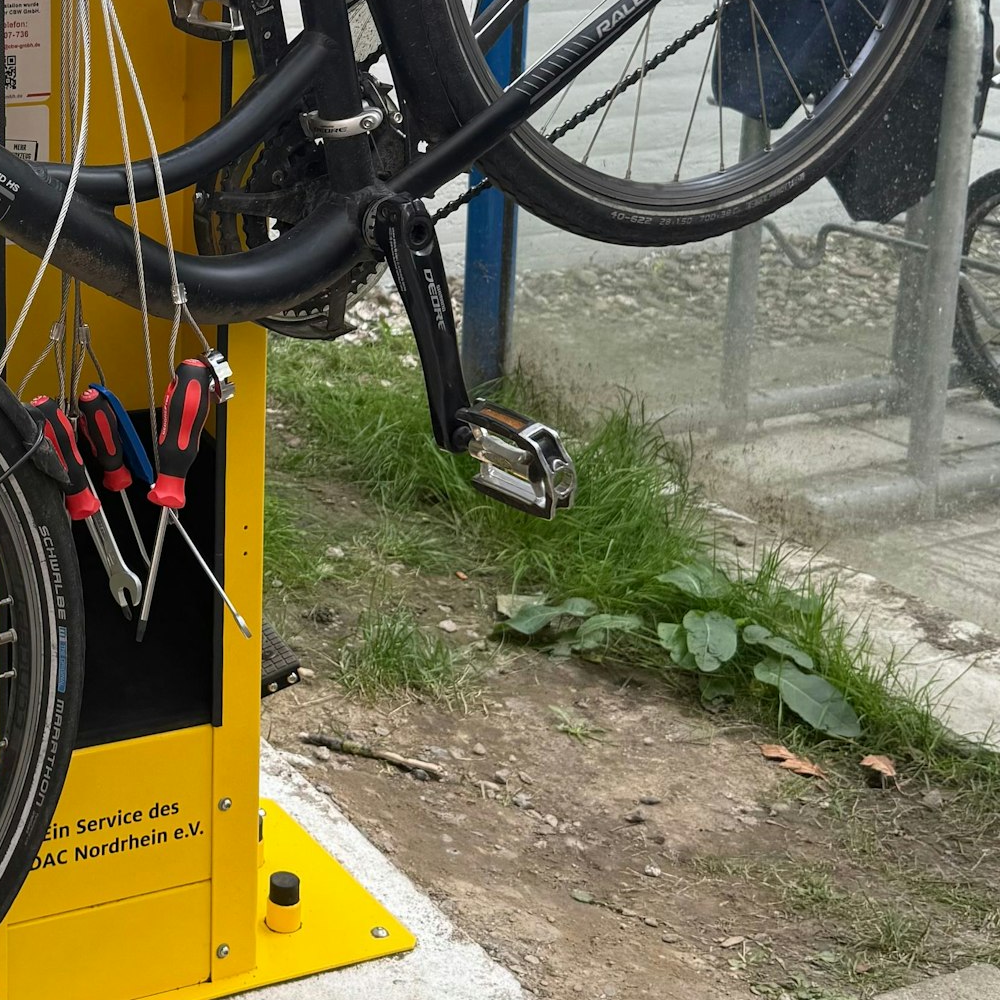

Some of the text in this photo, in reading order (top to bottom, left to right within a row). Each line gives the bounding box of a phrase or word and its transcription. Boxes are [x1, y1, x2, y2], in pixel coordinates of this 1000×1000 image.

[4, 21, 28, 29] elefon:
[4, 31, 29, 39] 07-736
[5, 180, 20, 193] HS
[423, 267, 446, 332] DEORE
[37, 524, 67, 621] SCHWALBE
[33, 699, 65, 808] MARATHON
[76, 810, 143, 834] Service
[148, 802, 180, 820] des
[30, 821, 204, 871] DAC Nordrhein e.V.
